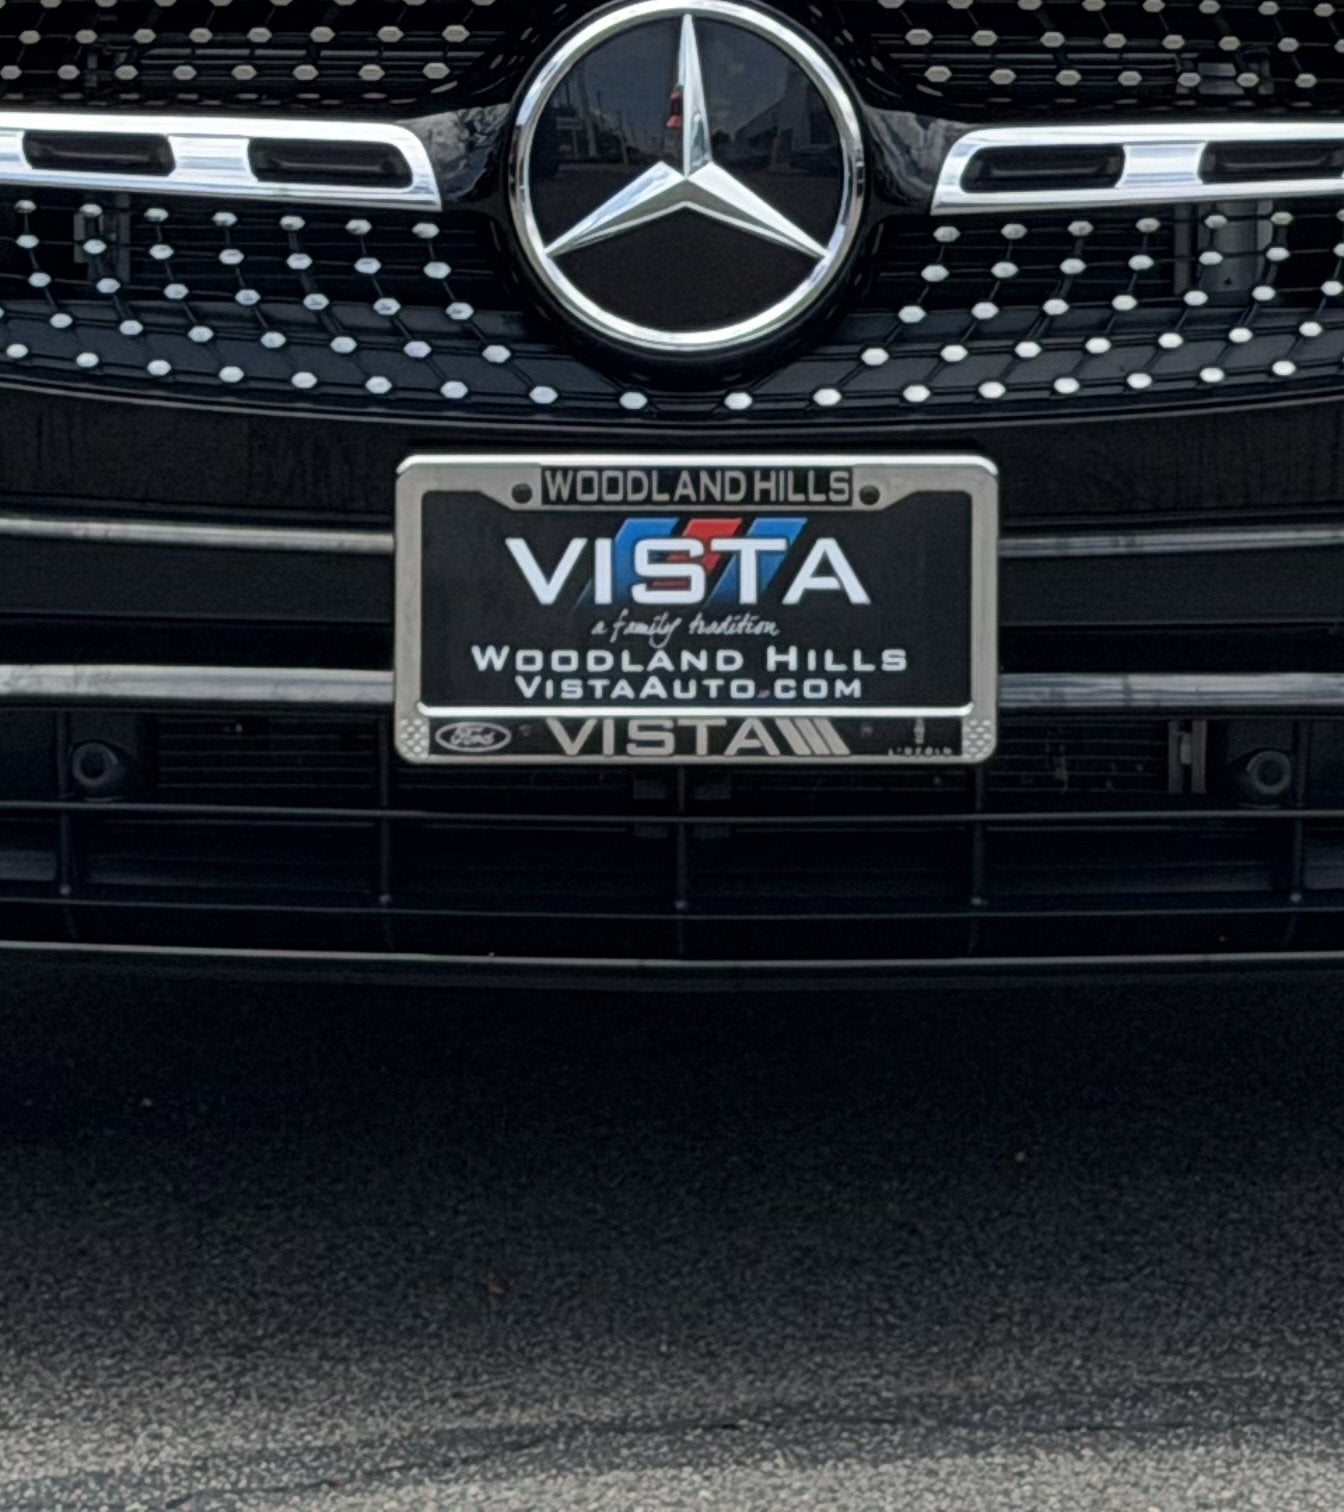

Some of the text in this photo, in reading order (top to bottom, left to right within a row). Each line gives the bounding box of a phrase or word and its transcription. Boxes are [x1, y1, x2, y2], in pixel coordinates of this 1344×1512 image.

[545, 470, 850, 503] WOODLAND HILLS
[504, 537, 872, 605] VISTA
[591, 608, 780, 649] a family tradition
[450, 726, 495, 746] Ford
[545, 718, 781, 757] VISTA
